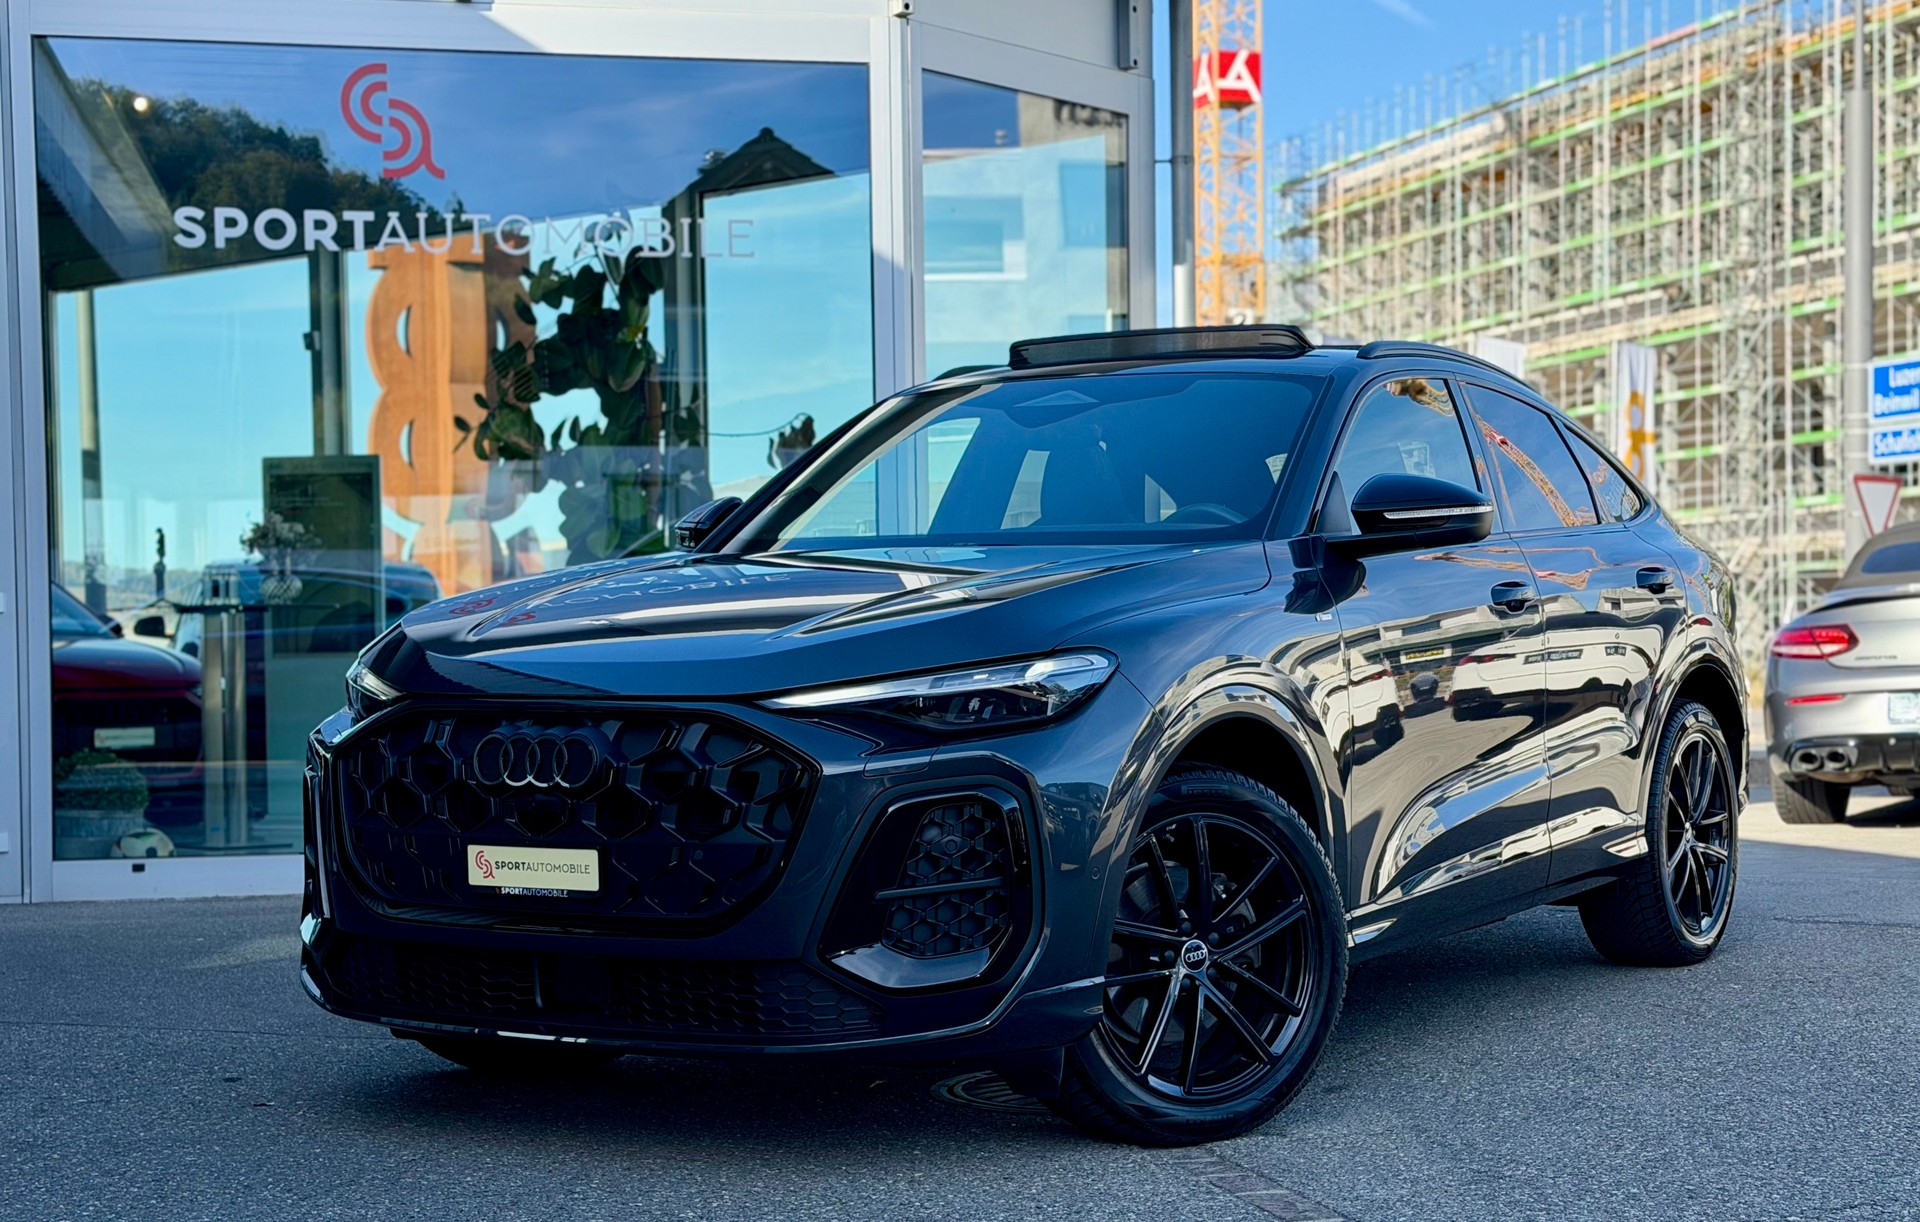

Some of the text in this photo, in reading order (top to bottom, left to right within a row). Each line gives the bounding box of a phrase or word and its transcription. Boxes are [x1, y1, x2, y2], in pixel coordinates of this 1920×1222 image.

[172, 206, 755, 258] SPORTAUTOMOBILE
[494, 860, 591, 875] SPORTAUTOMOBILE
[500, 886, 569, 898] SPORTAUTOMOBILE
